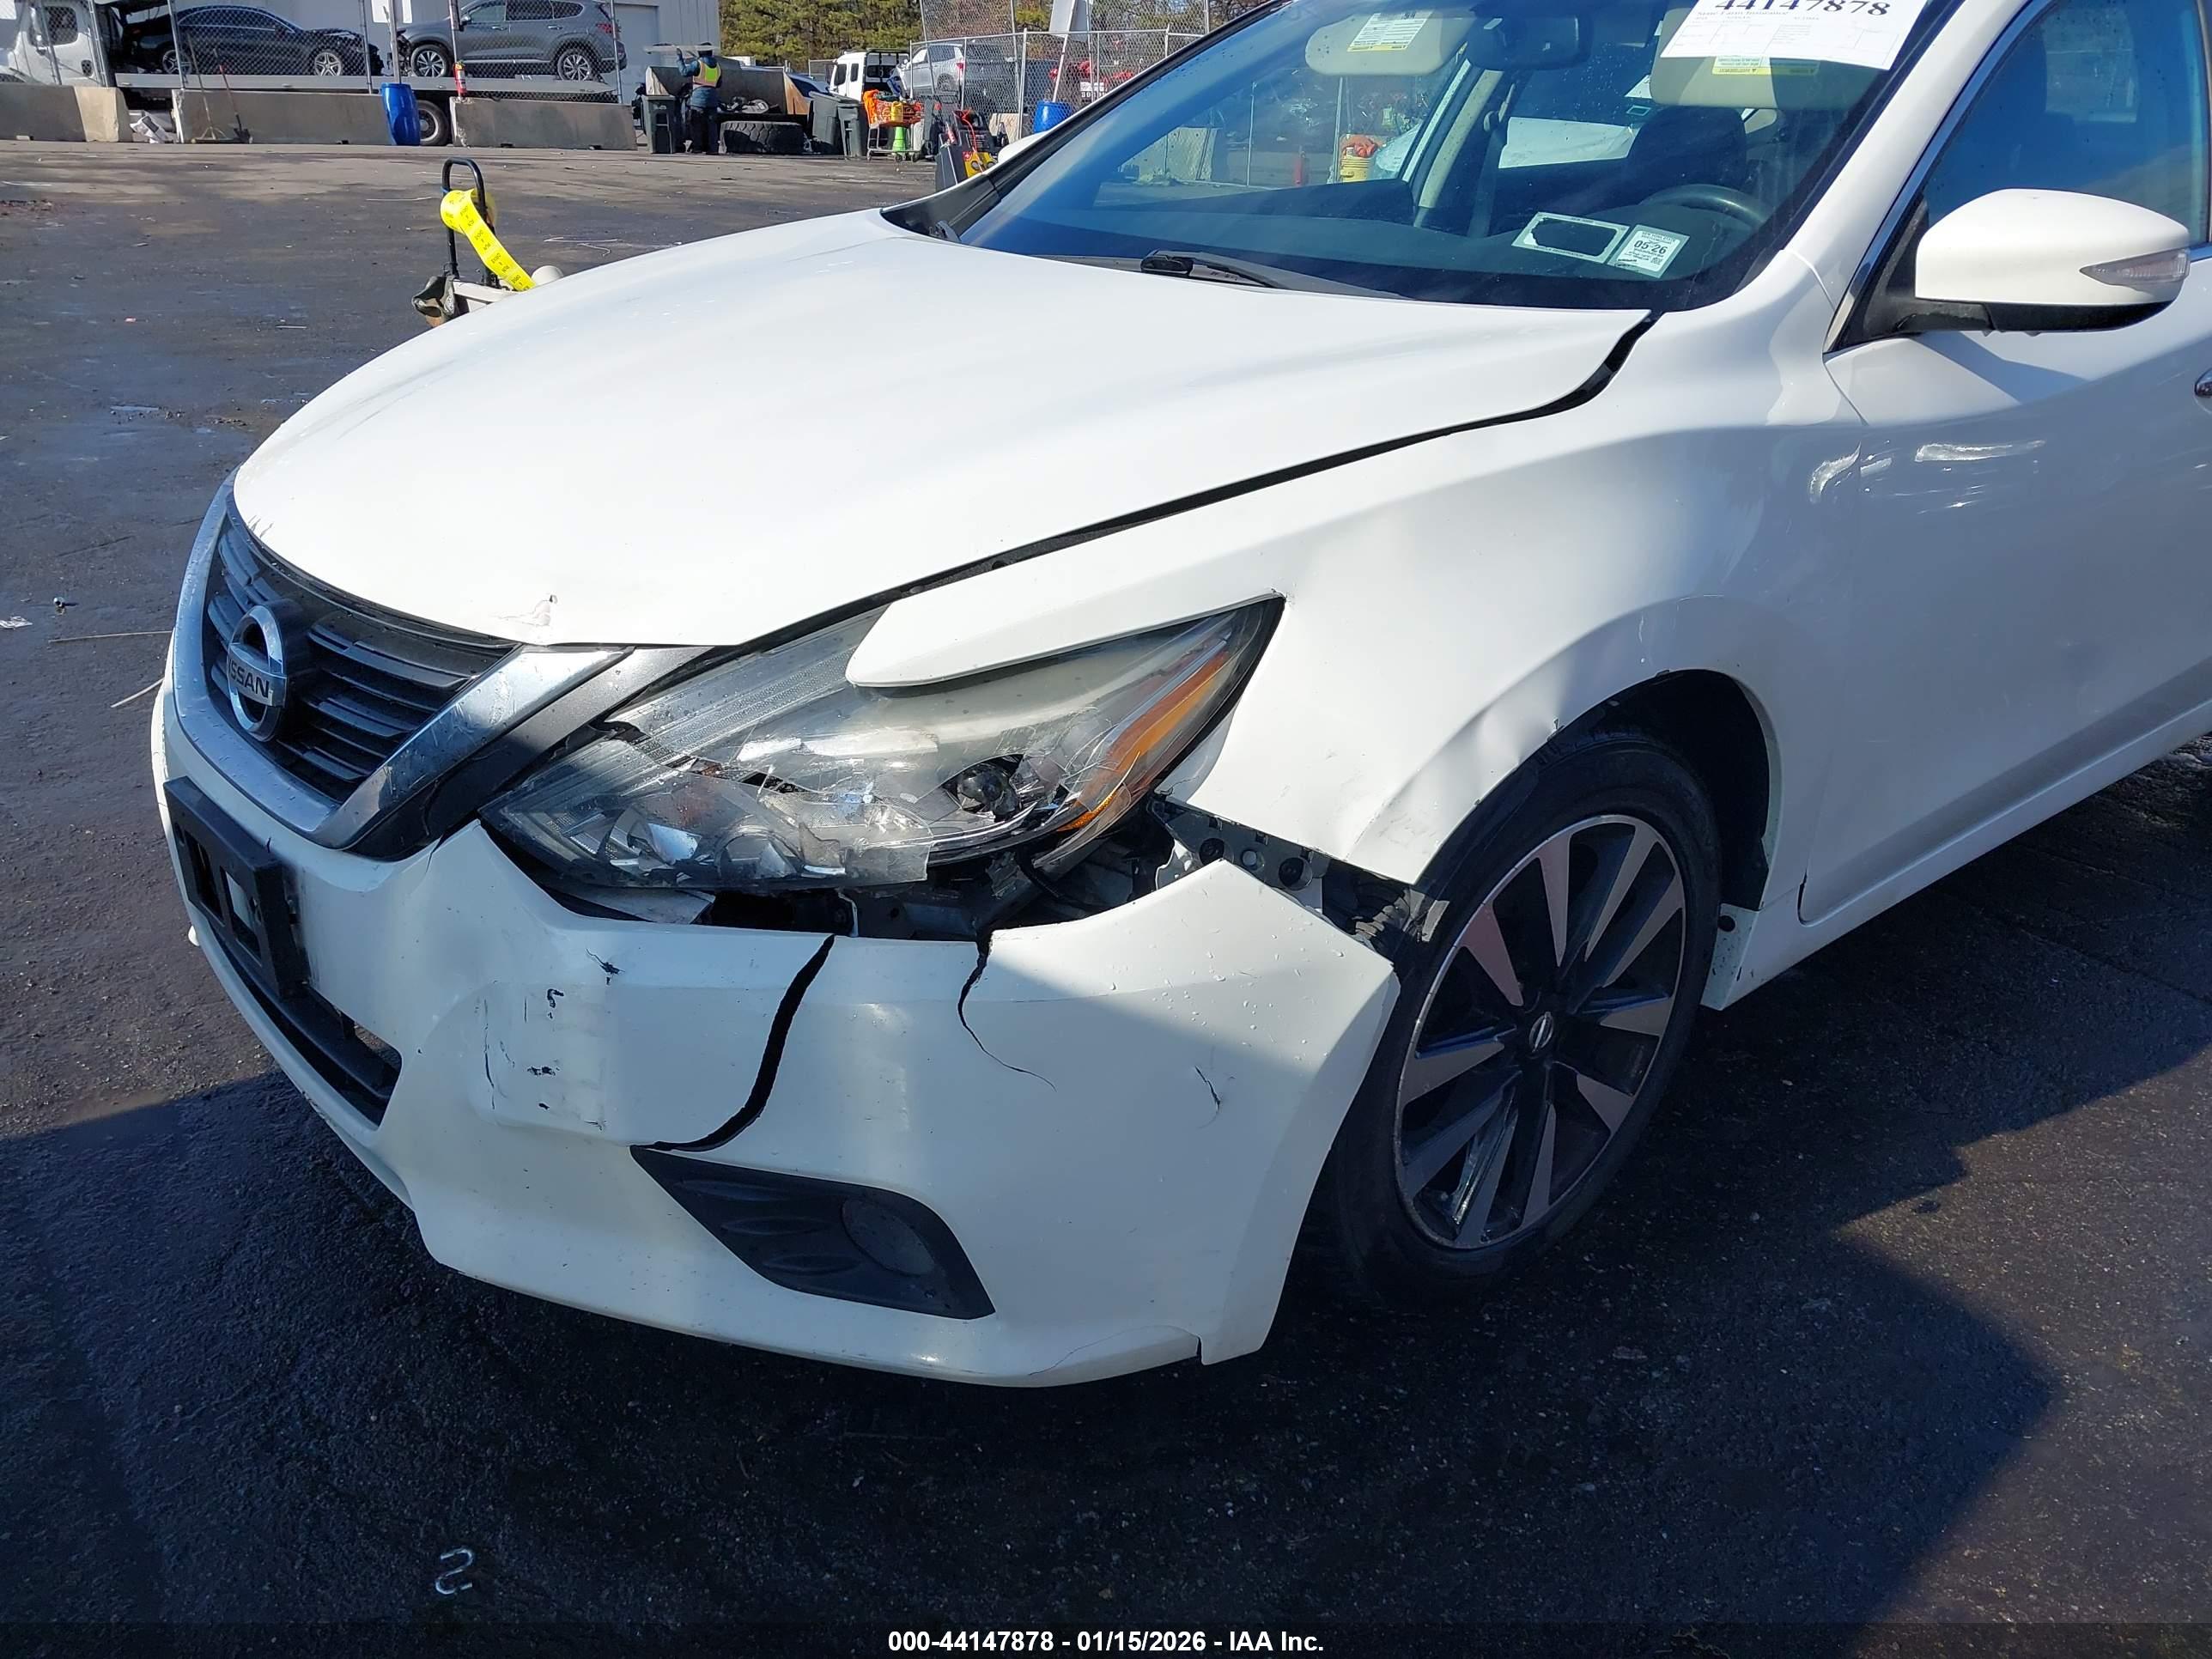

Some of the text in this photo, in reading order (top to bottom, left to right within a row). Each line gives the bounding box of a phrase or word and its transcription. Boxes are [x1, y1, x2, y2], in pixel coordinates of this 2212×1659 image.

[1715, 0, 1891, 16] 44147878
[1633, 240, 1650, 250] 05
[1650, 244, 1668, 254] 26
